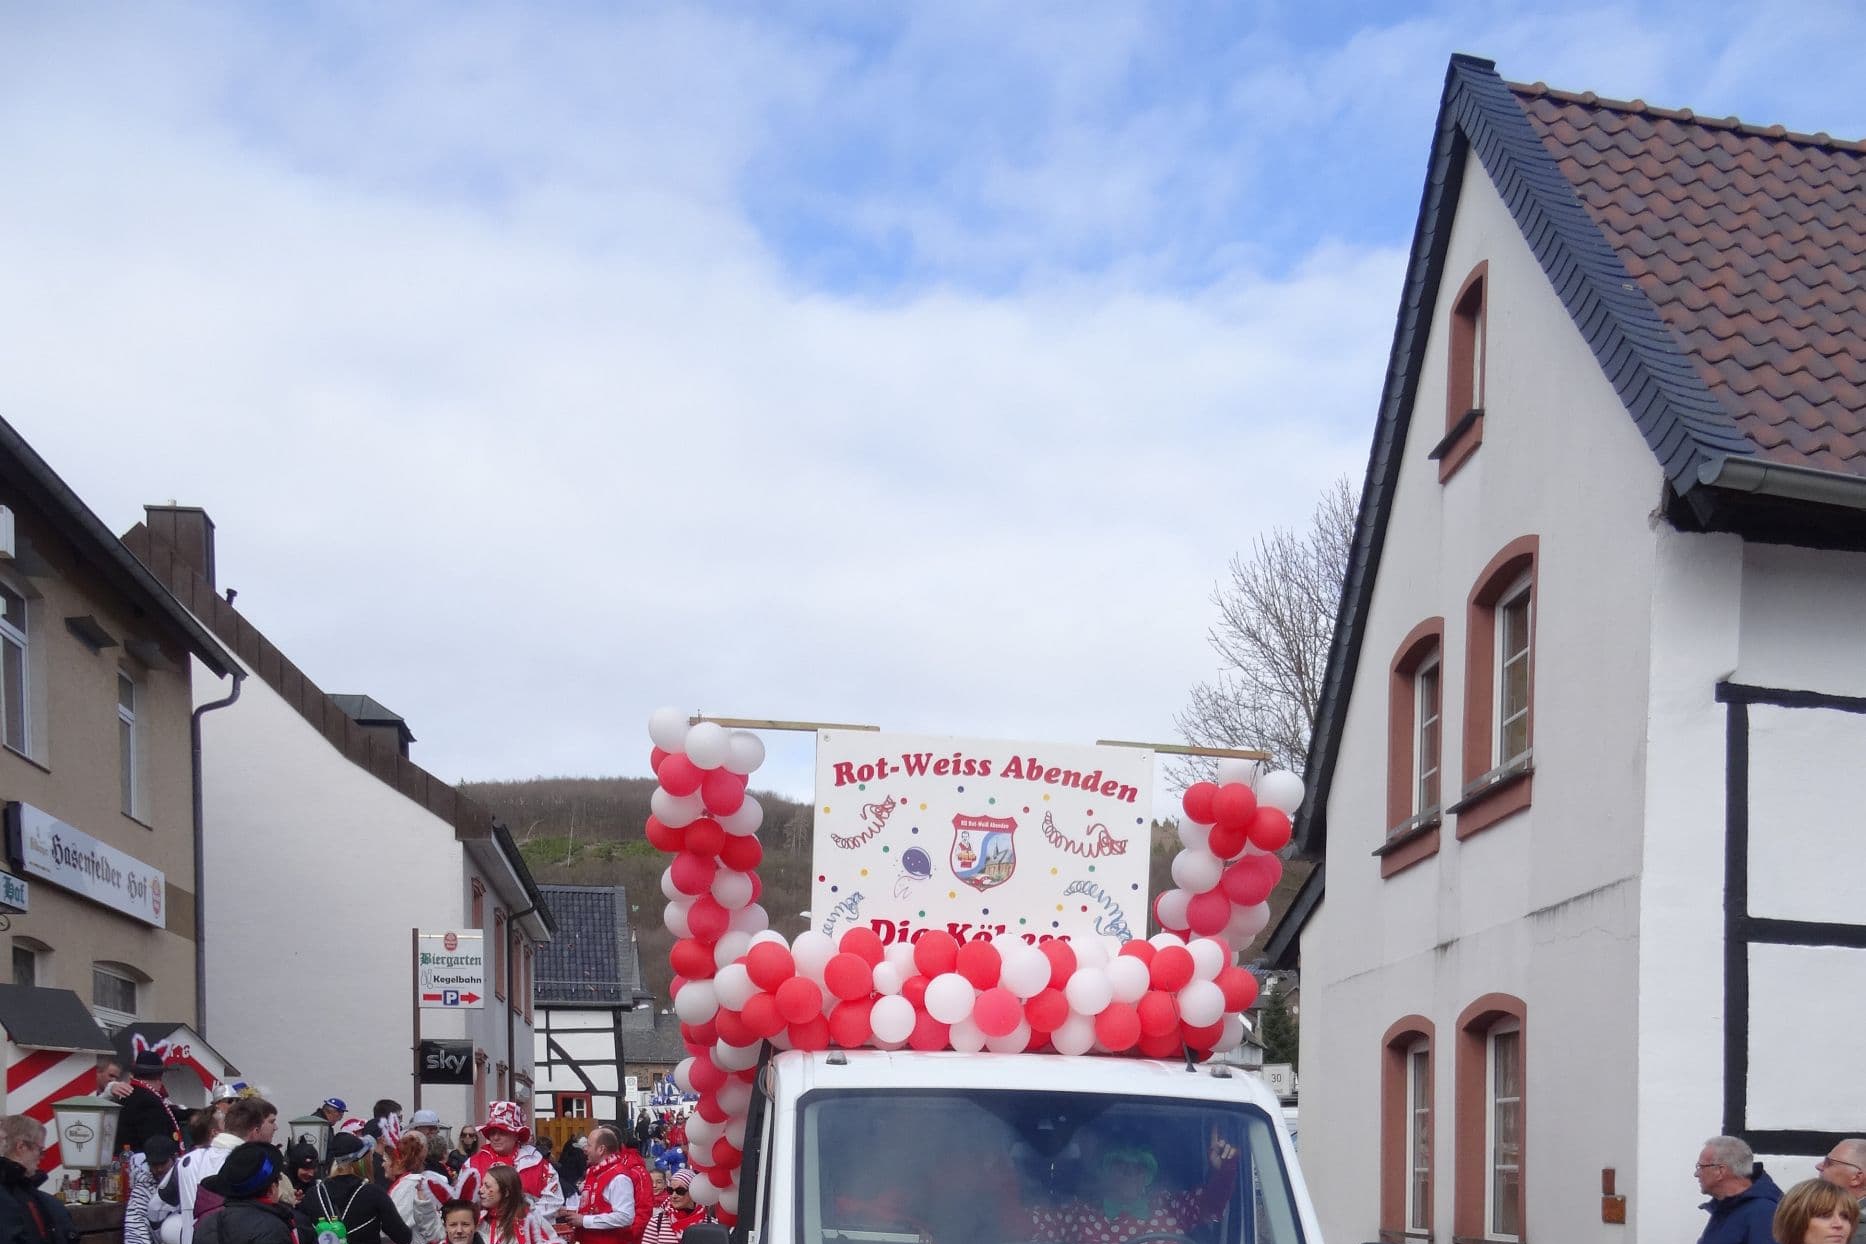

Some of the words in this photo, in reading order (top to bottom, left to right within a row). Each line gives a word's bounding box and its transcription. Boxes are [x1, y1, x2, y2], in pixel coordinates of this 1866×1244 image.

[833, 752, 992, 787] Rot-Weiss
[1000, 755, 1138, 802] Abenden
[52, 834, 121, 889] Hasenfelder
[128, 871, 147, 906] Hof
[420, 952, 481, 967] Biergarten
[433, 975, 481, 985] Kegelbahn
[427, 1050, 466, 1075] sky
[1272, 1074, 1281, 1082] 30
